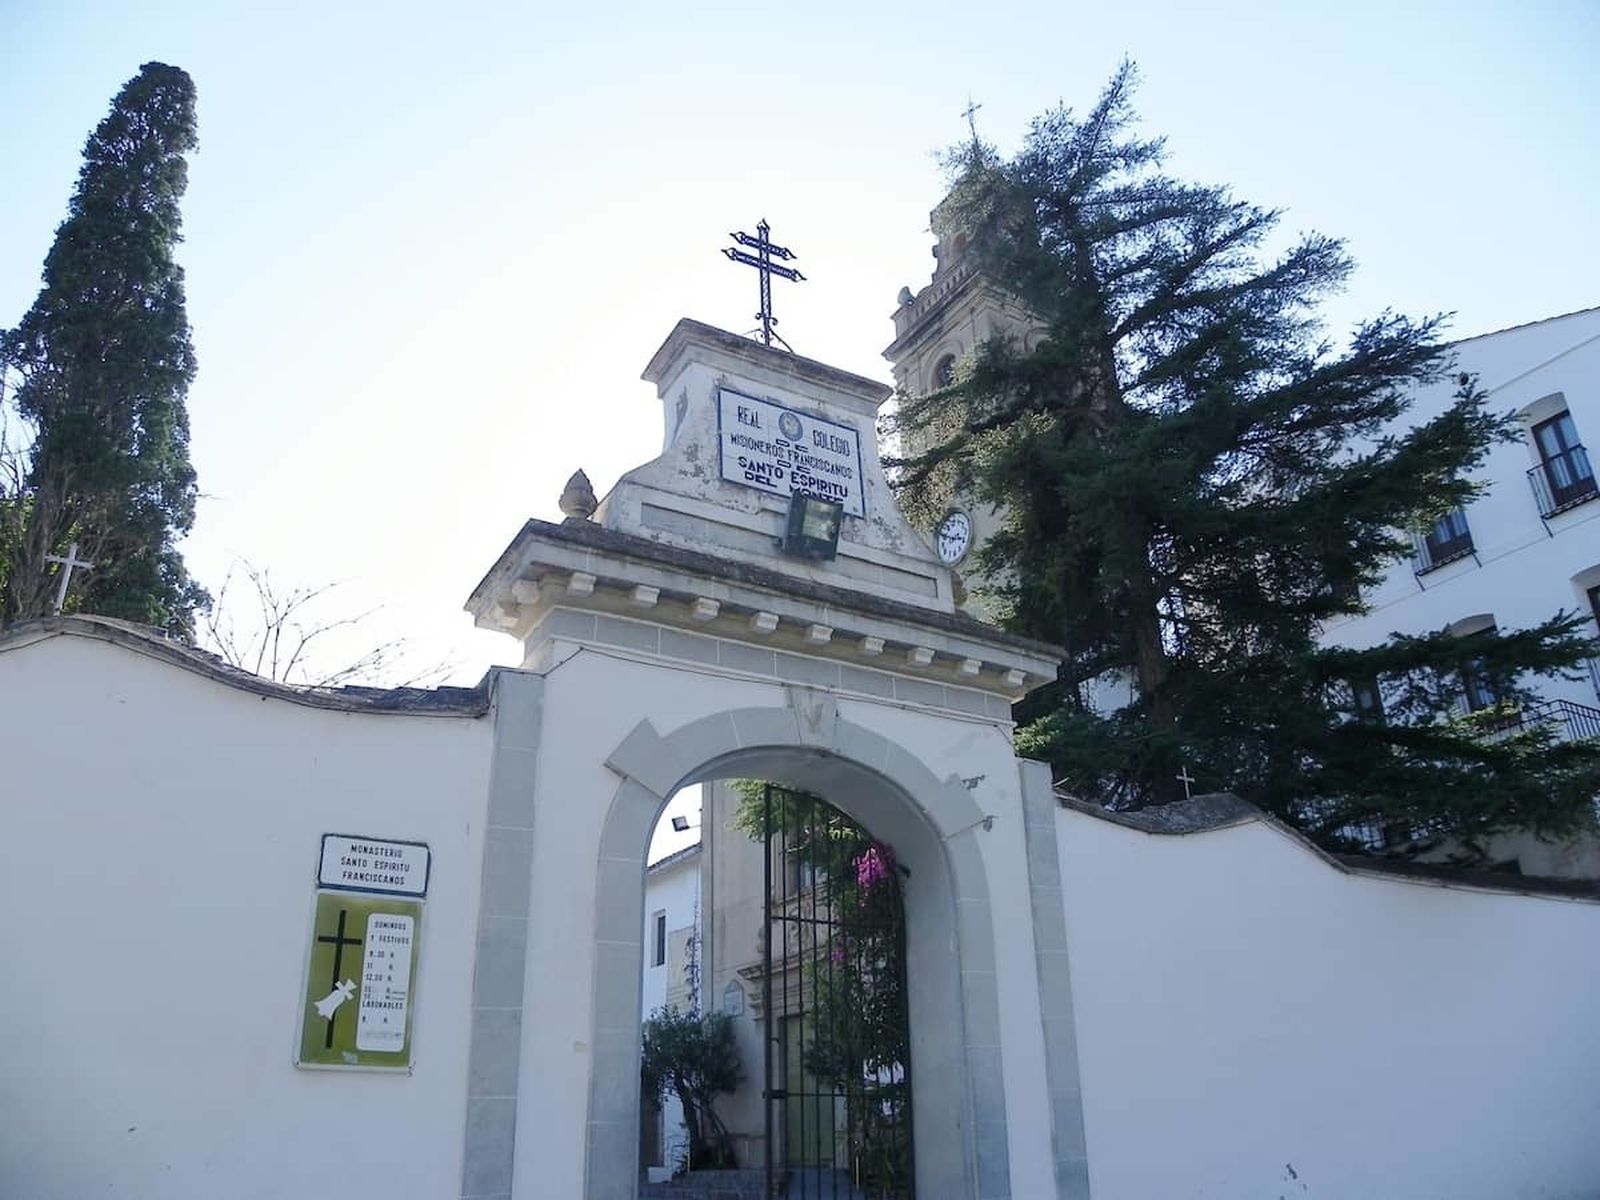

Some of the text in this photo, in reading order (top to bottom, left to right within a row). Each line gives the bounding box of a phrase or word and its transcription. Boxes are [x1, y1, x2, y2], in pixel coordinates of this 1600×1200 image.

[737, 405, 850, 457] REAL COLEGIO
[775, 438, 809, 453] DE
[731, 433, 853, 480] MISIONEROS FRANCISCANOS
[777, 460, 811, 475] DE
[738, 456, 848, 498] SANTO ESPIRITU
[744, 471, 778, 488] DEL
[351, 844, 403, 858] MONASTERIO
[340, 856, 410, 872] SANTO ESPIRITU
[342, 870, 405, 885] FRANCISCANOS
